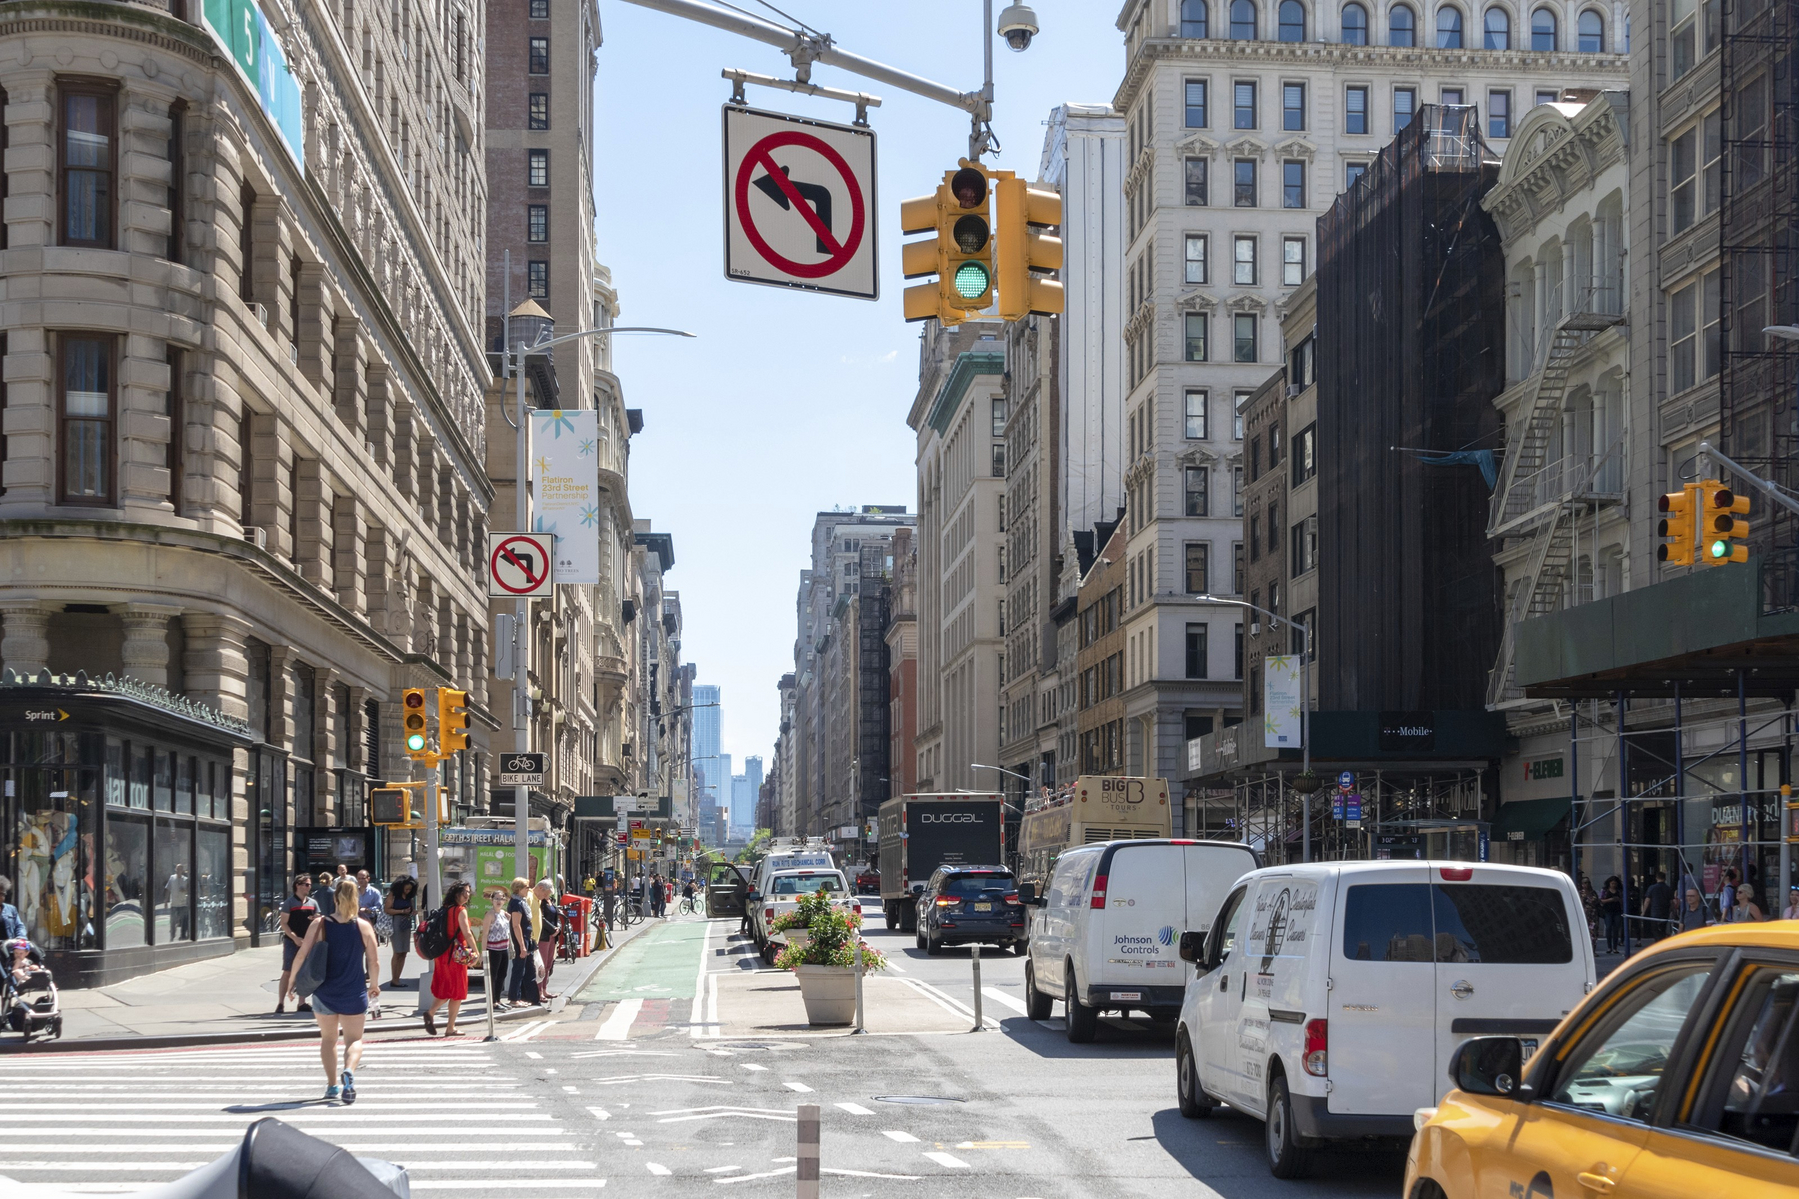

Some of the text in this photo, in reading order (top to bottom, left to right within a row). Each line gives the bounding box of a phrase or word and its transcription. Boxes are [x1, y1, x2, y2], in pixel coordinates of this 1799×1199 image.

[244, 7, 253, 67] 5
[731, 268, 751, 276] SR-652
[541, 476, 574, 484] Flatiron
[541, 492, 589, 501] Partnership
[25, 710, 56, 721] Sprint
[502, 775, 541, 783] BIKE LANE
[1102, 780, 1126, 792] BIG
[1101, 793, 1126, 804] BUS
[1711, 804, 1743, 825] DUAN
[772, 860, 781, 868] RUN
[791, 858, 815, 866] MECHANICAL
[815, 858, 827, 866] CORP
[1114, 935, 1152, 945] Johnson
[1120, 945, 1160, 954] Controls
